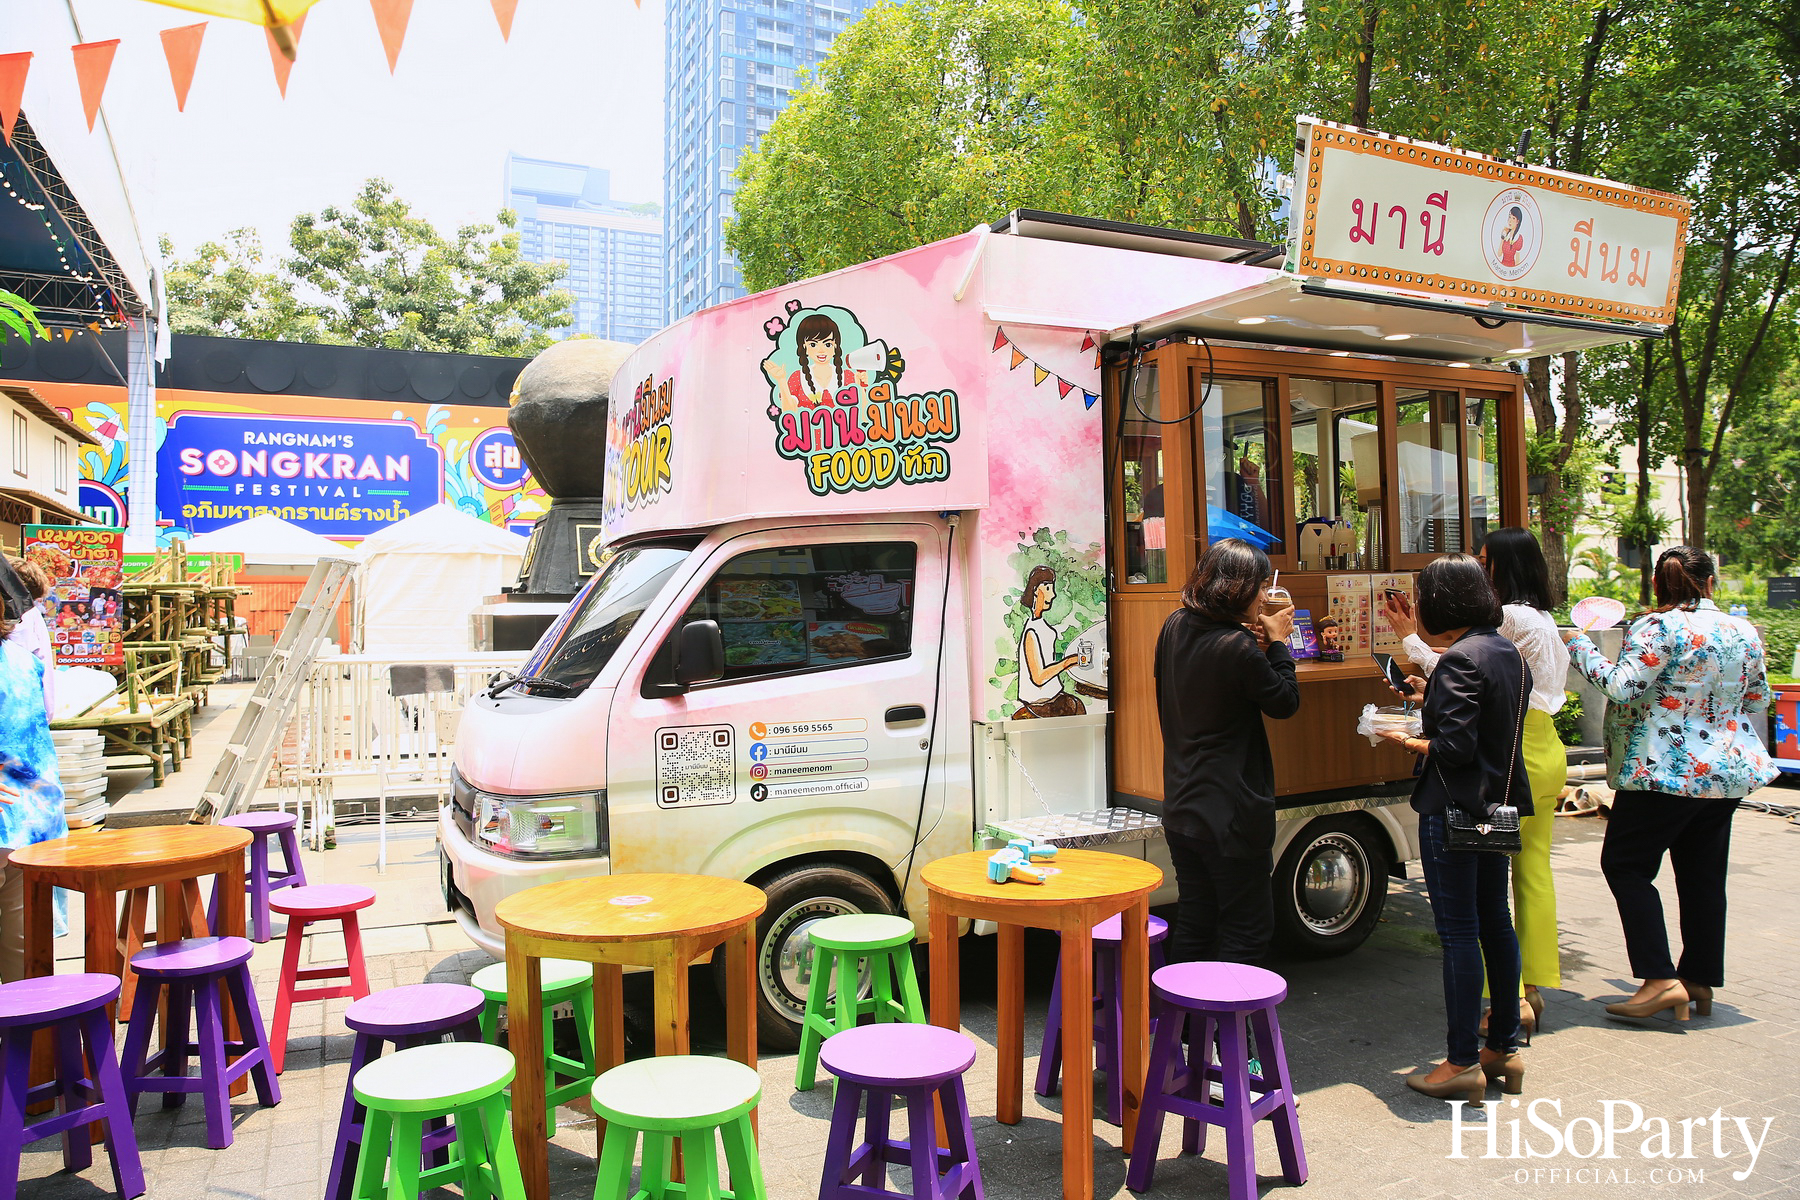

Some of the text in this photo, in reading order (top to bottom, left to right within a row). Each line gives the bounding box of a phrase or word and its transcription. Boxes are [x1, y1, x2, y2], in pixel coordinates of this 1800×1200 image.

[1348, 188, 1652, 289] มานี มีนม
[781, 382, 954, 452] มานีมีนม
[244, 431, 354, 448] RANGNAM'S
[179, 447, 411, 482] SONGKRAN
[620, 424, 672, 505] TOUR
[810, 445, 944, 488] FOOD ทัก
[235, 483, 362, 498] FESTIVAL
[182, 499, 411, 522] อภิมหาสงกรานต์รางน้ำ
[37, 529, 115, 550] หมูทอด
[773, 725, 791, 735] 096
[792, 724, 809, 733] 569
[811, 723, 833, 732] 5565
[773, 745, 808, 755] มานีมีนม
[774, 764, 833, 775] maneemenom
[774, 781, 863, 796] maneemenom.official
